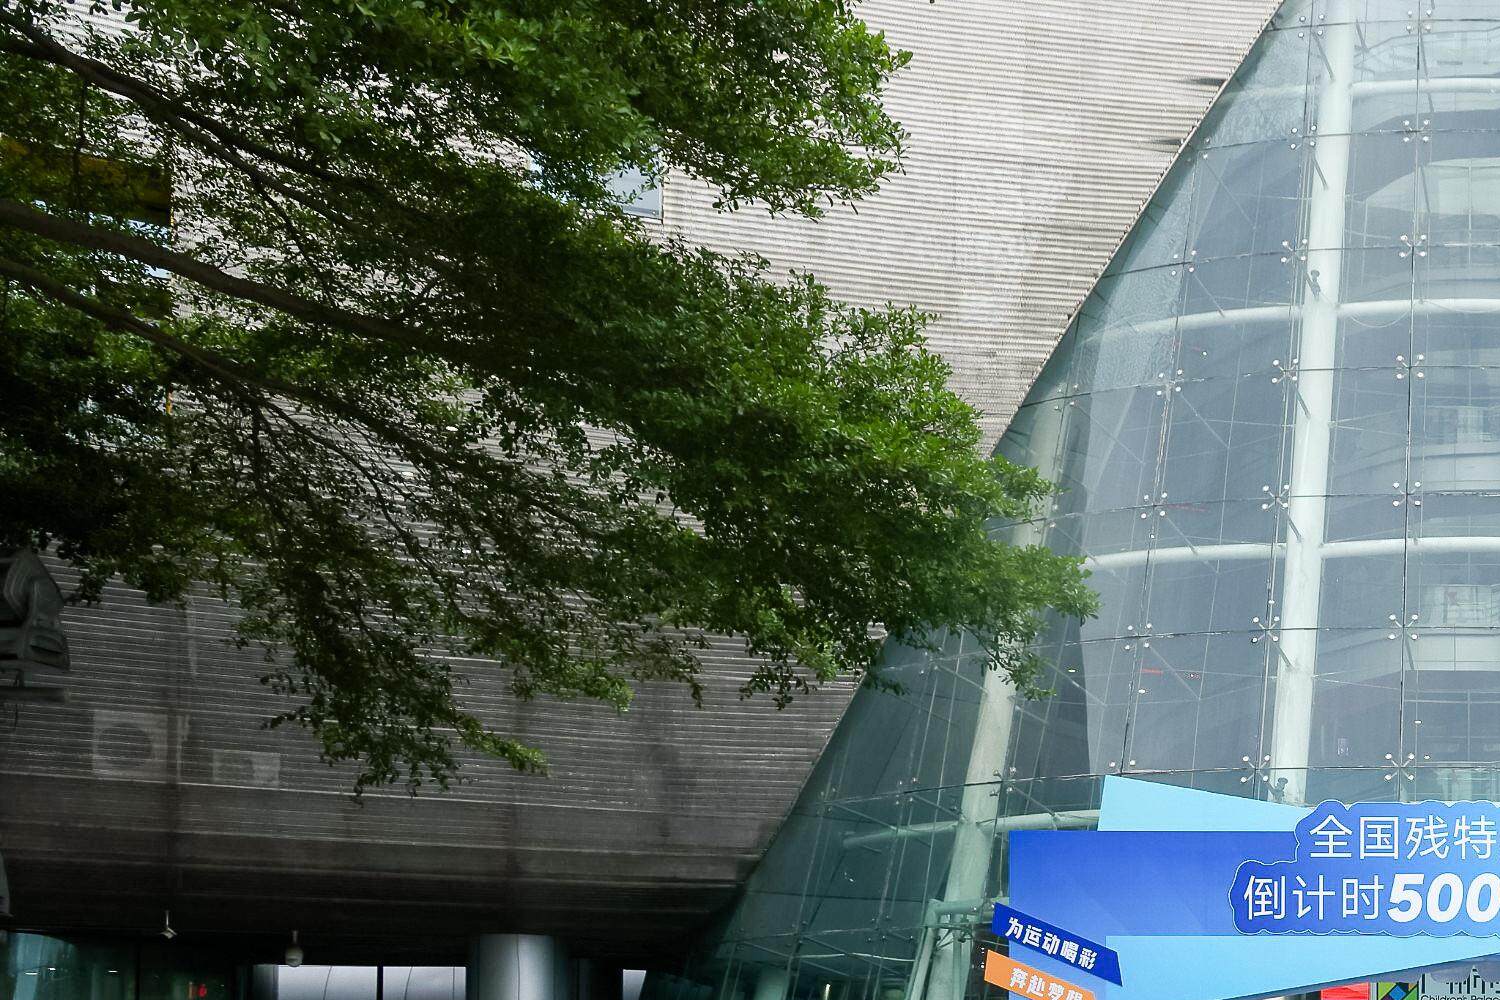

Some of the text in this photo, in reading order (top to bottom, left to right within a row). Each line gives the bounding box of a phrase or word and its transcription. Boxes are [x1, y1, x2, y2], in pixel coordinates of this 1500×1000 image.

[1004, 916, 1098, 970] 为运动喝彩
